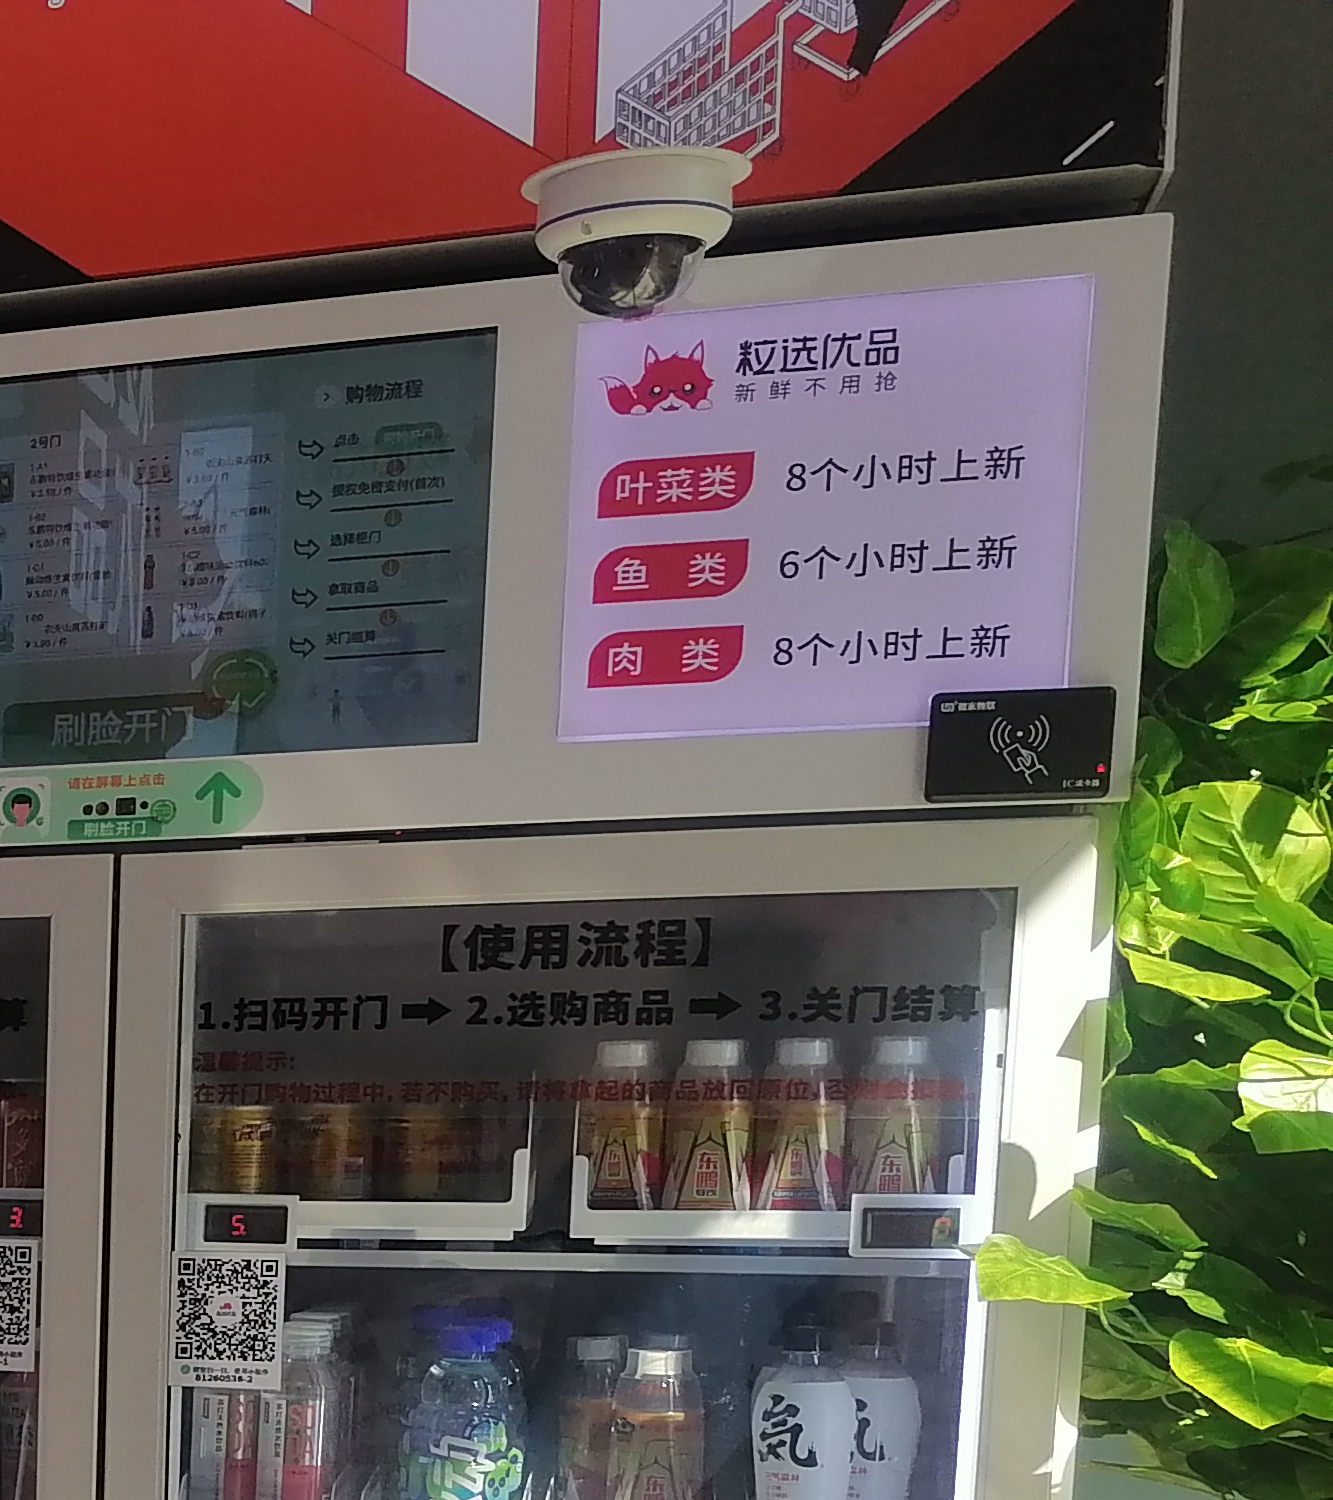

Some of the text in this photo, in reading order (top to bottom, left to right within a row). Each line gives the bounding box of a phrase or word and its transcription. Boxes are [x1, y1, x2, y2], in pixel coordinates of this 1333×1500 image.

[735, 328, 900, 376] 粒选优品
[345, 379, 423, 405] 购物流程
[734, 371, 898, 402] 新鲜不用抢
[30, 435, 61, 449] 2号门
[615, 445, 1026, 505] 叶菜类 8个小时上新
[779, 535, 1017, 580] 6个小时上新
[773, 623, 1011, 666] 8个小时上新
[51, 705, 194, 747] 刷脸开门
[68, 773, 166, 790] 请在屏幕上点击
[83, 820, 147, 837] 刷脸开门
[436, 917, 715, 974] 【使用流程】
[196, 984, 980, 1034] 1.扫码开门 2.选购商品 3.关门结算
[696, 1151, 721, 1188] 东鹏
